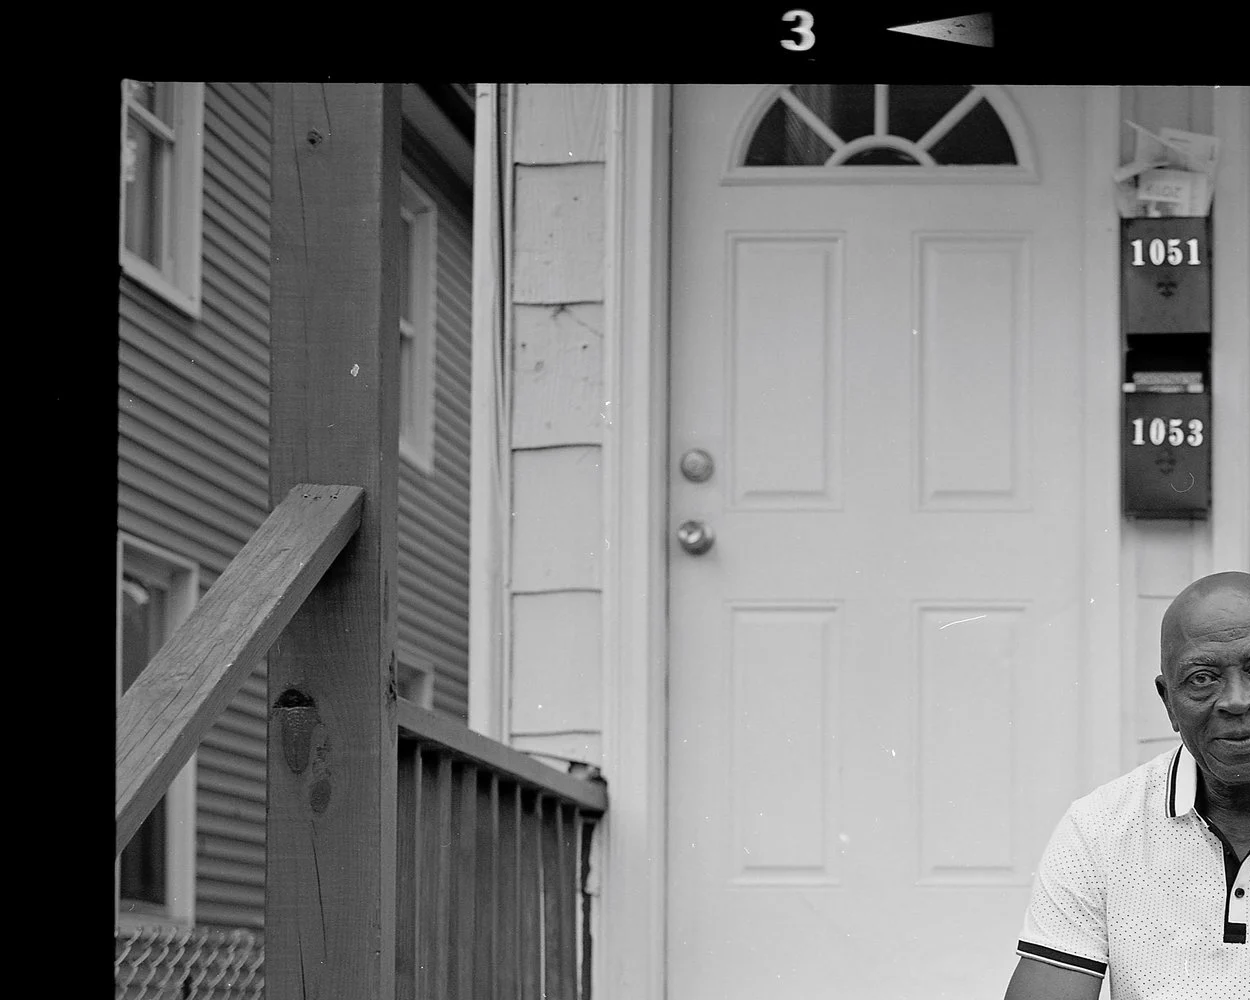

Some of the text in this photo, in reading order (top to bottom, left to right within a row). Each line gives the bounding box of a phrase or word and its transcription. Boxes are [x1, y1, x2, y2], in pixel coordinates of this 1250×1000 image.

[779, 9, 816, 52] 3
[1130, 238, 1201, 266] 1051
[1132, 417, 1204, 447] 1053
